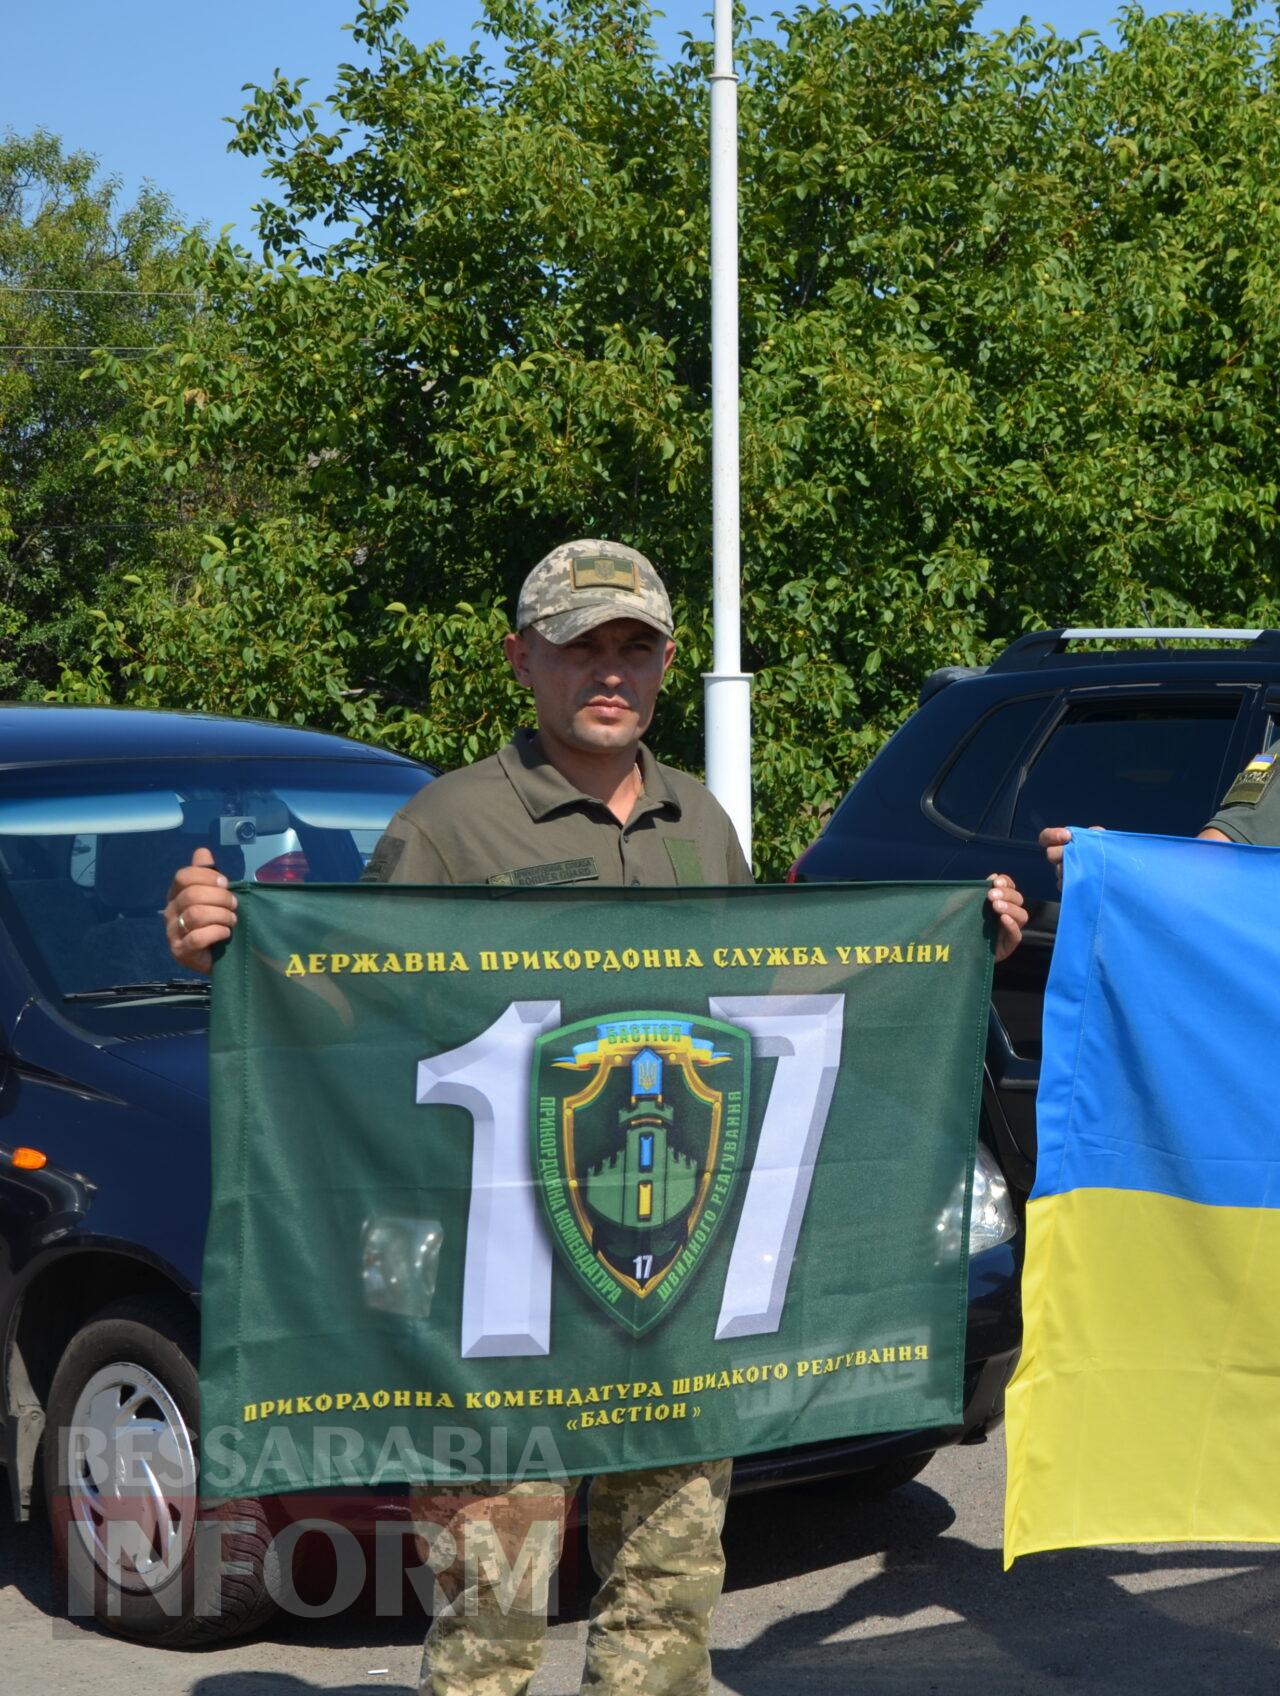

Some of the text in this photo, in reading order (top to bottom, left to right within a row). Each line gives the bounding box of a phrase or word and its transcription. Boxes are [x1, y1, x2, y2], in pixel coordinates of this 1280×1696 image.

[285, 941, 950, 978] ДЕРЖАВНА ПРИКОРДОННА СЛУЖБА УКРАЇНИ
[606, 1023, 682, 1044] БАСТІОН
[416, 993, 846, 1358] 17
[540, 1096, 623, 1305] ПРИКОРДОННА КОМЕНДАТУРА
[656, 1091, 742, 1303] ШВИДКОГО РЕАГУВАННЯ
[632, 1254, 654, 1280] 17
[243, 1345, 930, 1423] ПРИКОРДОННА КОМЕНДАТУРА ШВИДКОГО РЕАГУВАННЯ
